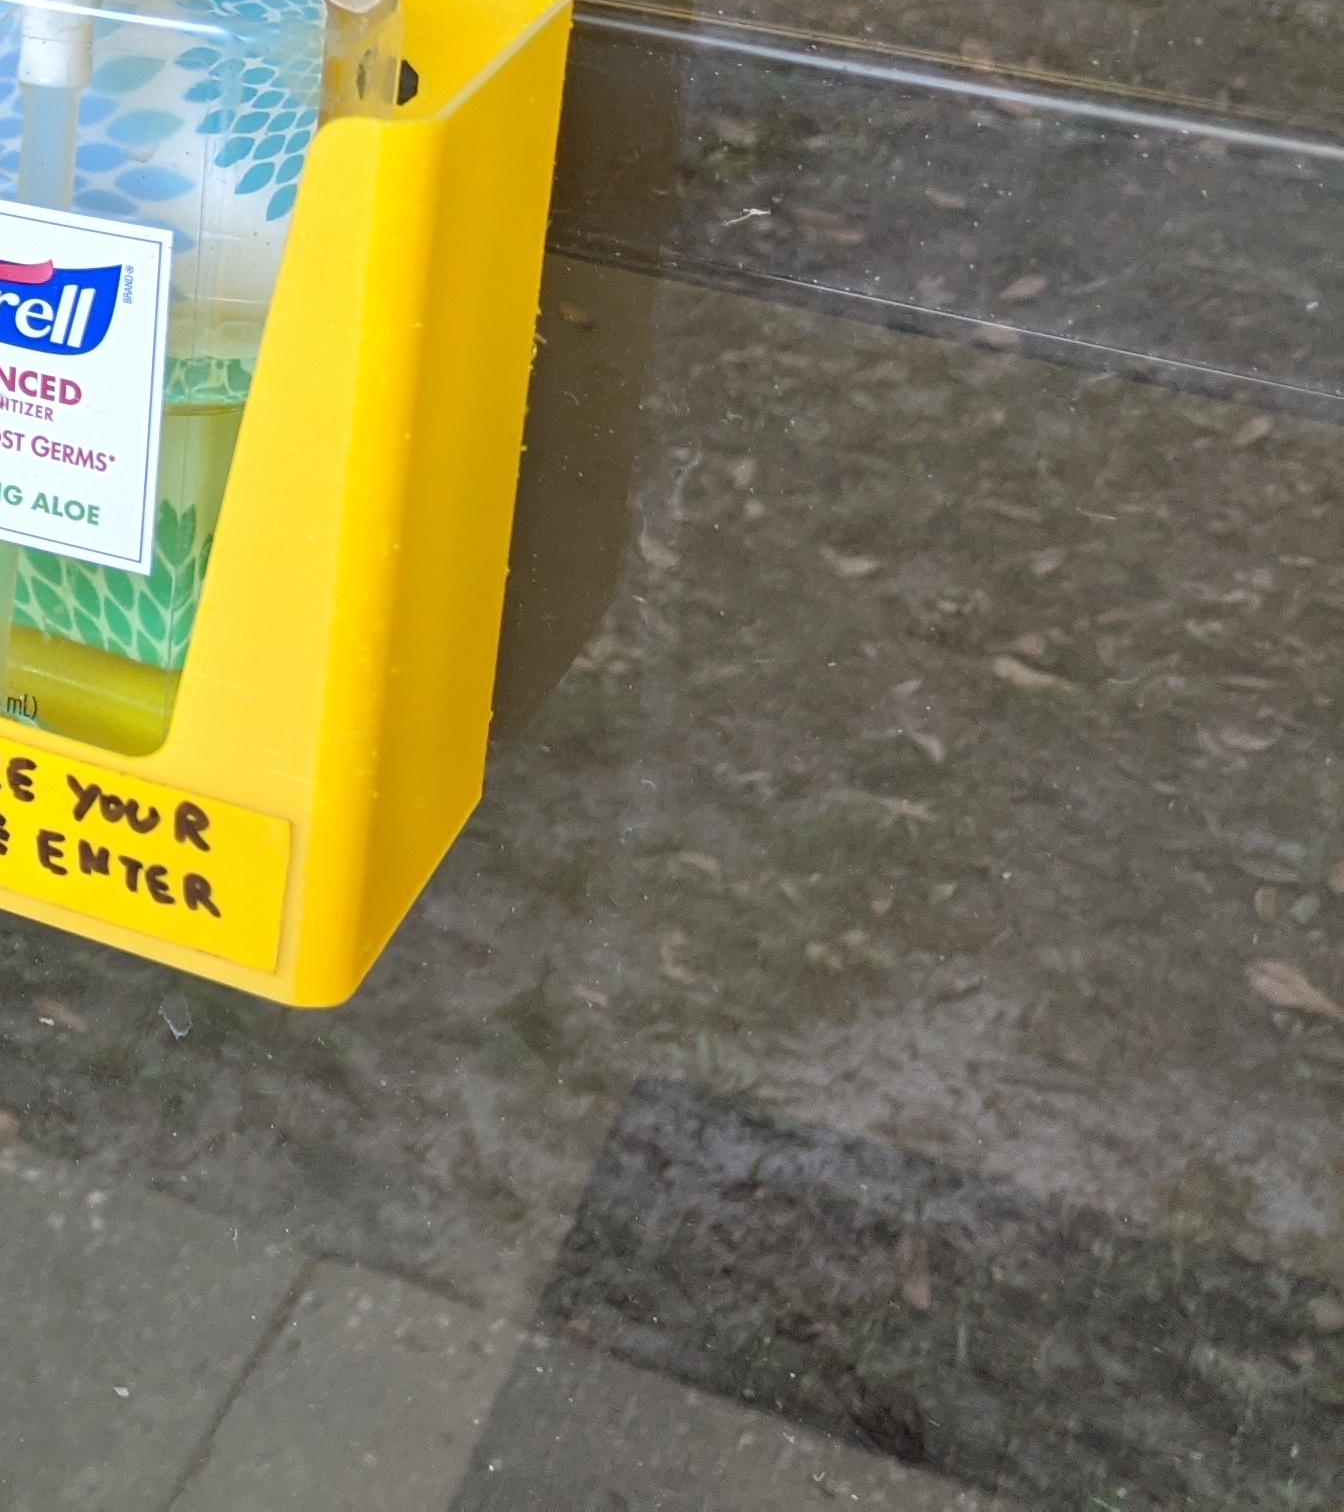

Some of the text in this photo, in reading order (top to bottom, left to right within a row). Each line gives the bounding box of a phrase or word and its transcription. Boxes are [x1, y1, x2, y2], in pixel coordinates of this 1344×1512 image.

[31, 492, 101, 526] ALOE
[67, 774, 212, 853] YOUR
[35, 830, 223, 919] ENTER
